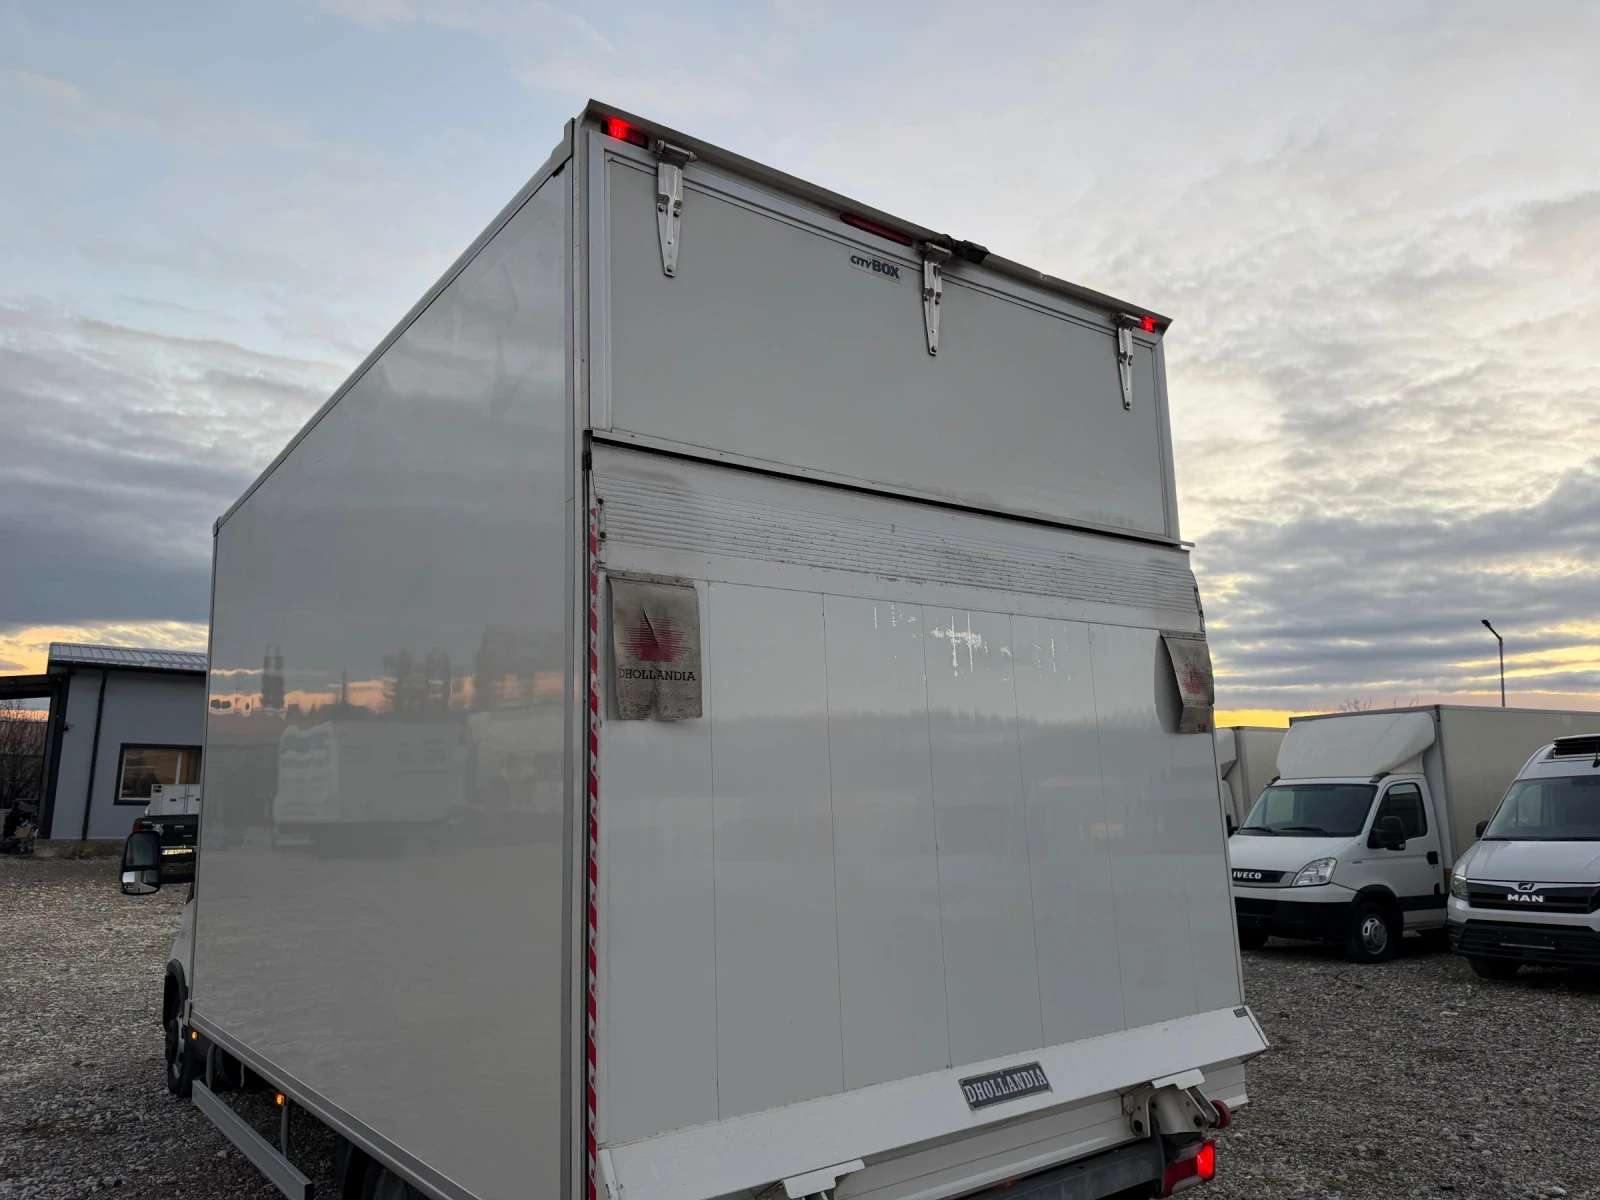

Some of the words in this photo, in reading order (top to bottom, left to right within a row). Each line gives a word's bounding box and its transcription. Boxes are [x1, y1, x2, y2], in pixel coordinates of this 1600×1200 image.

[851, 255, 900, 280] CITYBOX
[619, 667, 696, 682] DHOLLANDIA
[1233, 871, 1262, 880] IVECO
[1507, 893, 1544, 903] MAN
[963, 1068, 1048, 1103] DHOLLANDIA
